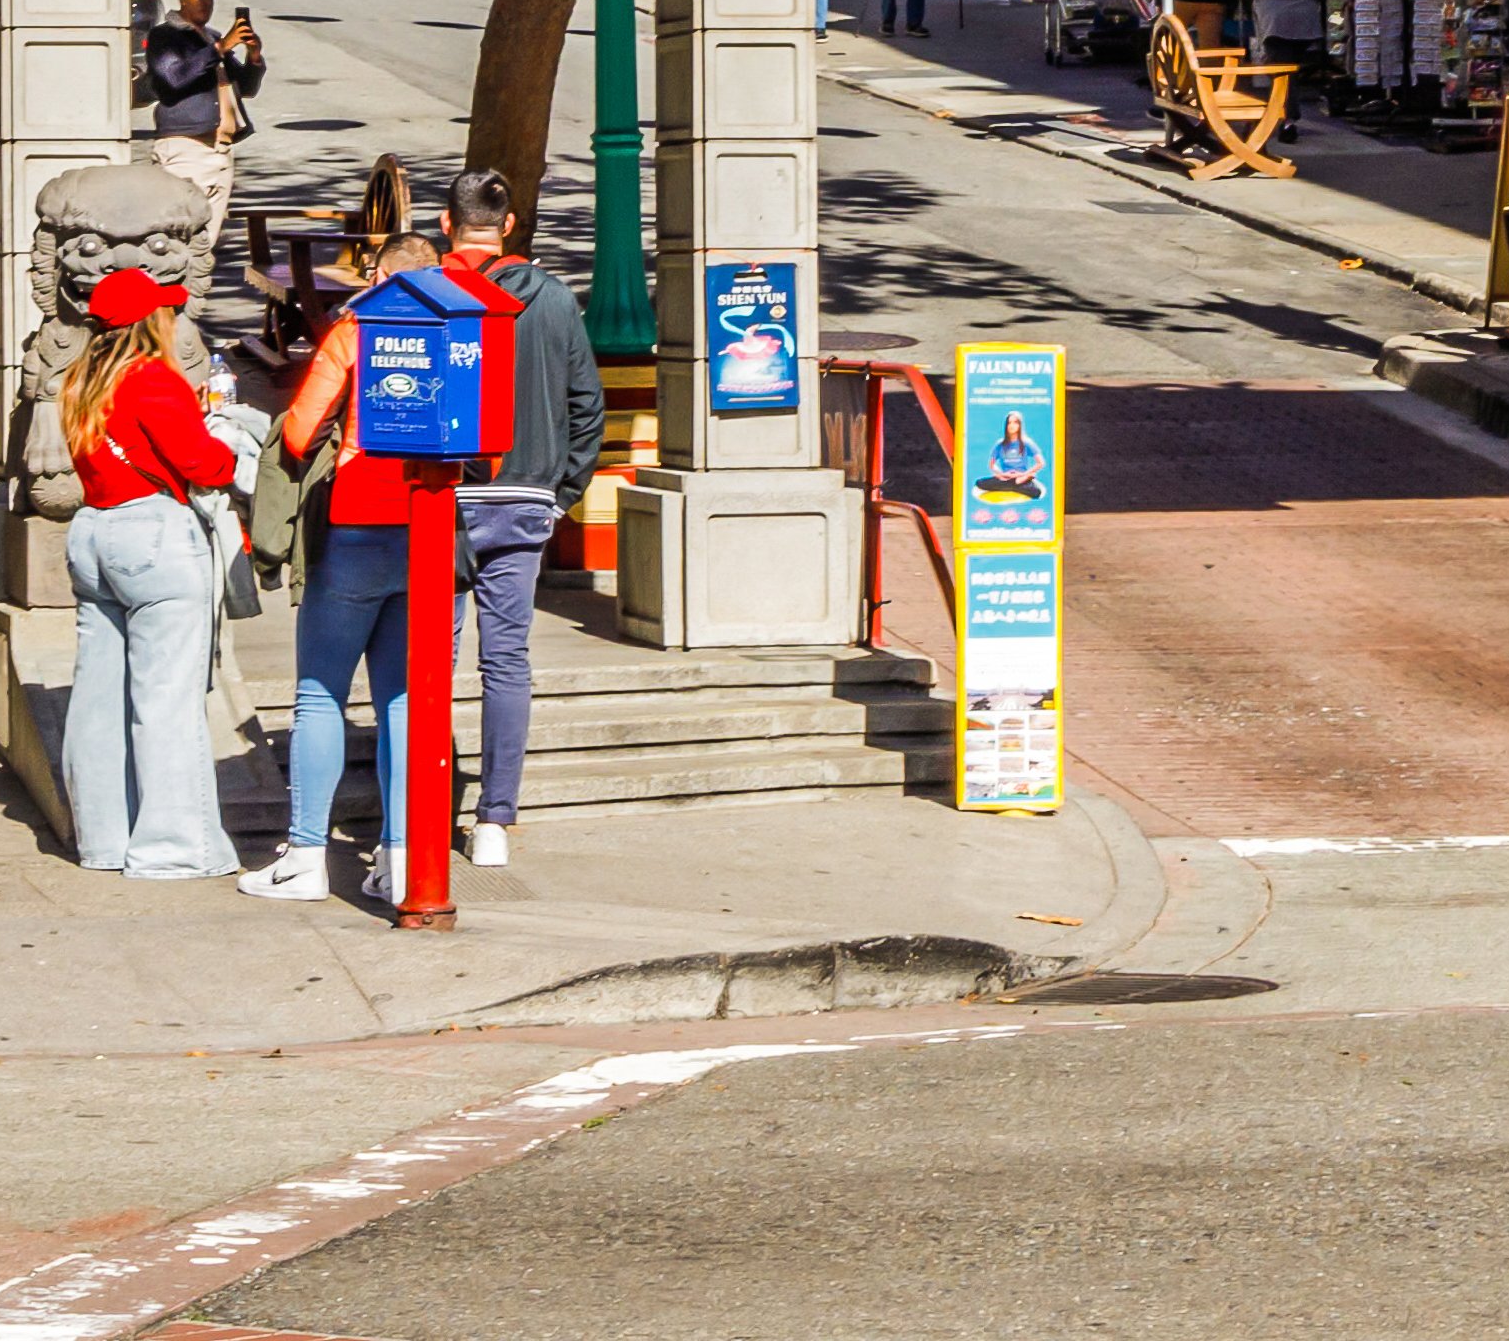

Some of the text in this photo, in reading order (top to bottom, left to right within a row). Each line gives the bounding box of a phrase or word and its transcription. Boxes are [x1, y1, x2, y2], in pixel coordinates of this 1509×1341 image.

[717, 292, 787, 306] SHEN YUN
[375, 336, 426, 354] POLICE
[371, 355, 432, 370] TELEPHONE
[969, 360, 1052, 374] FALUN DAFA
